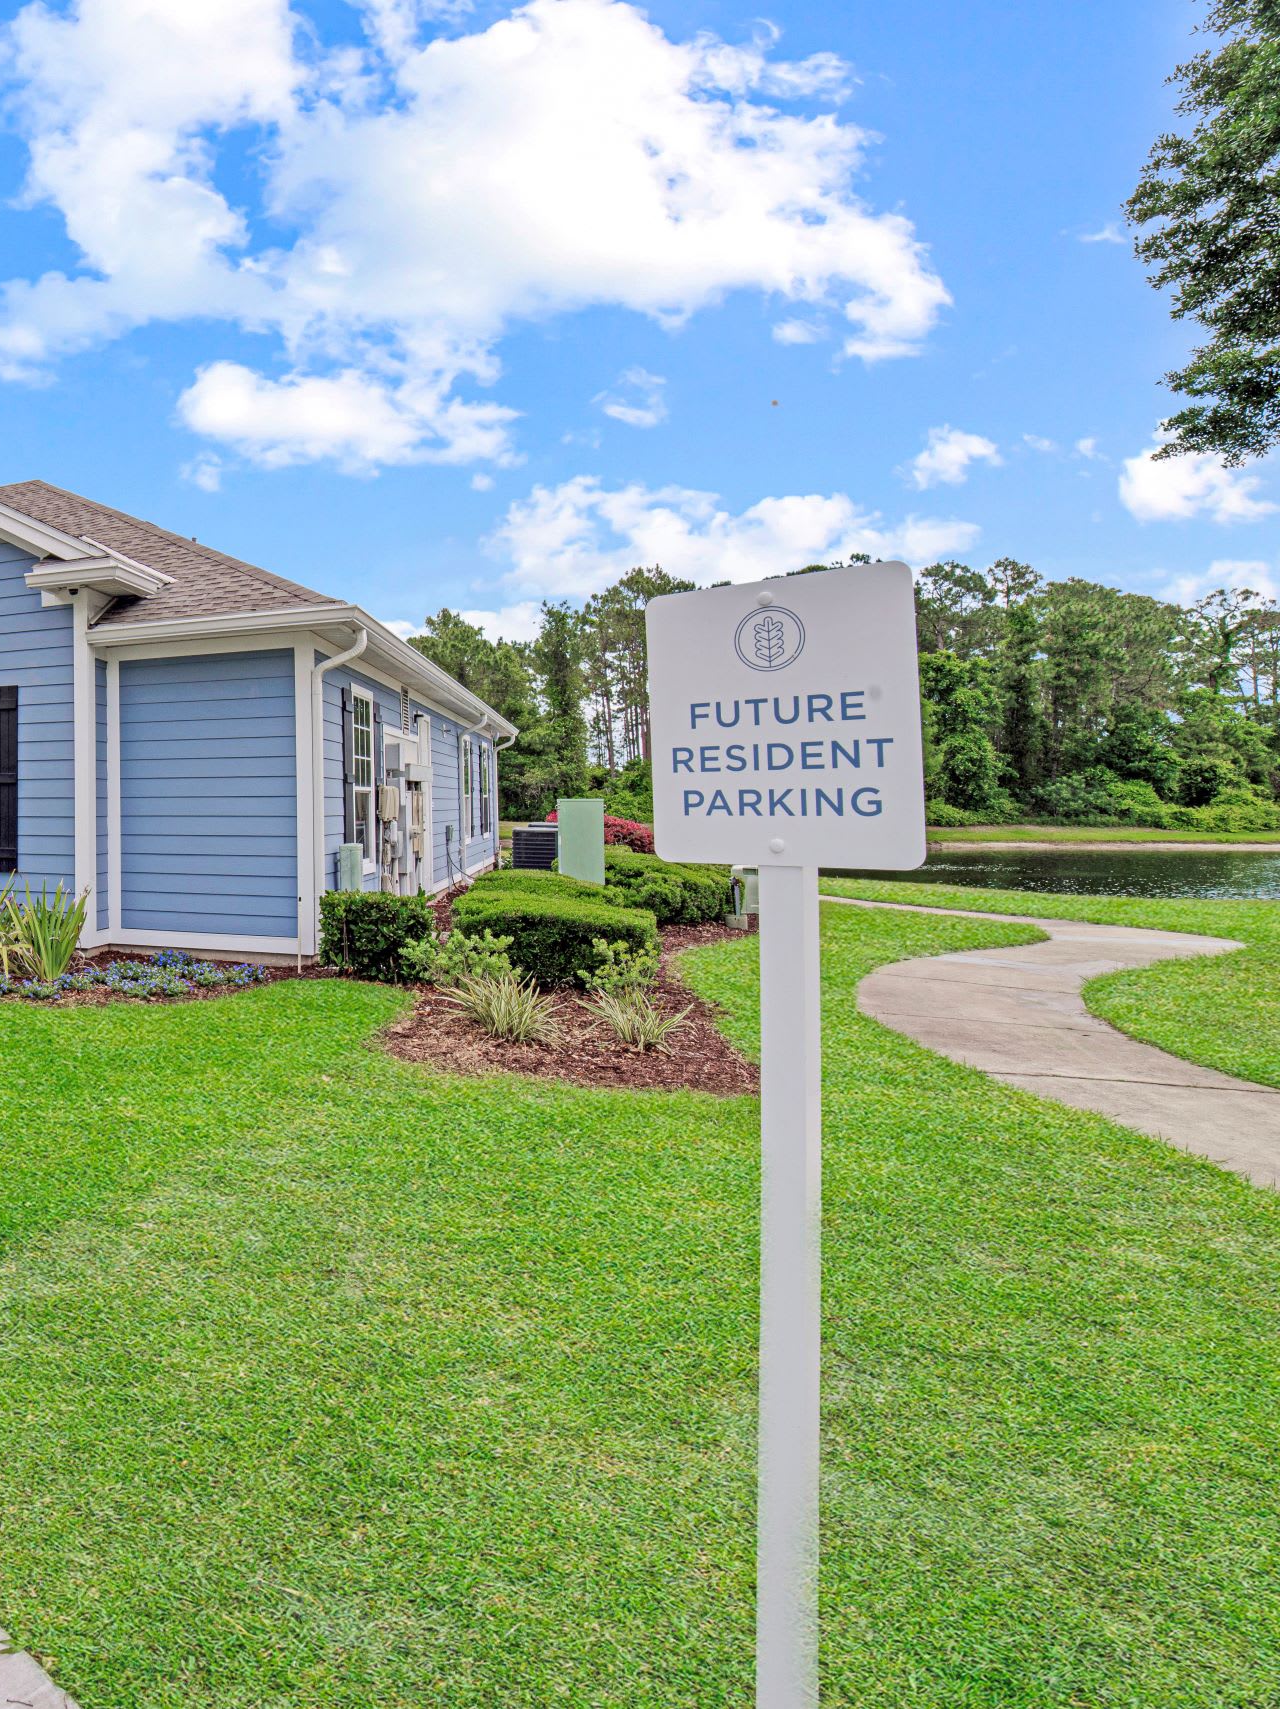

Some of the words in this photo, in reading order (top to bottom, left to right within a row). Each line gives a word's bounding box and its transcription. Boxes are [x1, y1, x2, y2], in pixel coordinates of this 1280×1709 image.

[690, 691, 866, 729] FUTURE
[672, 738, 894, 773] RESIDENT
[683, 787, 883, 817] PARKING
